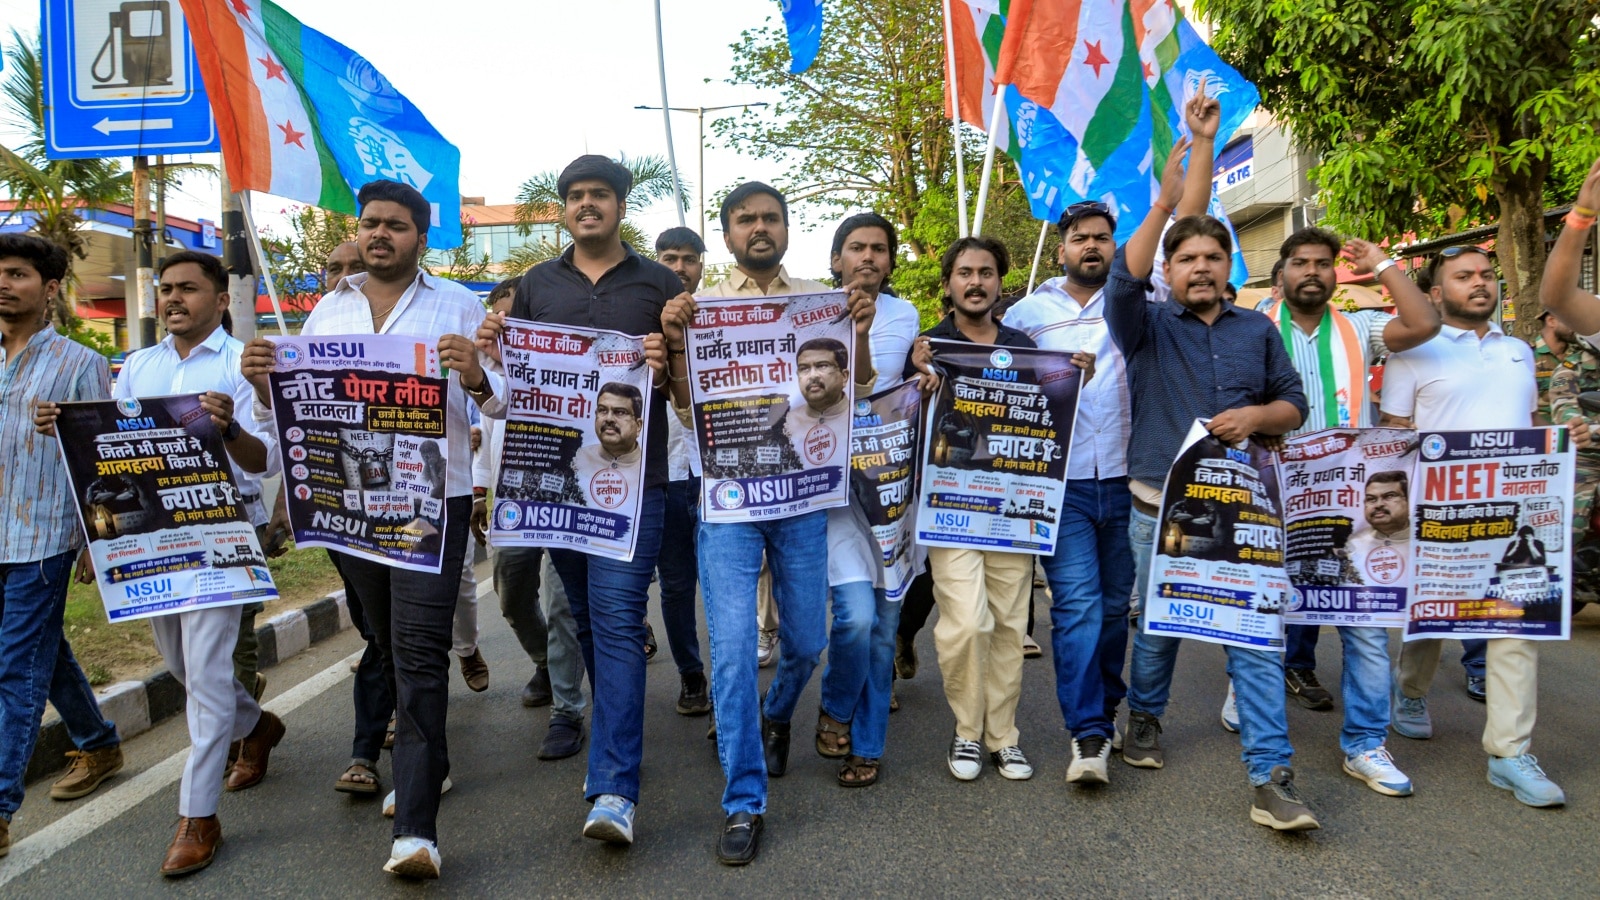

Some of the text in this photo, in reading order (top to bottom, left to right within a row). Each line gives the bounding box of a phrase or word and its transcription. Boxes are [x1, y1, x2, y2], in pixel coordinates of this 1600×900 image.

[694, 306, 774, 327] नीट पेपर लीक
[794, 305, 842, 326] LEAKED
[528, 332, 552, 350] पेपर
[554, 336, 582, 352] लीक
[695, 328, 724, 340] मामले में
[308, 342, 364, 358] NSUI
[600, 352, 640, 365] LEAKED
[540, 368, 580, 390] प्रधान
[582, 370, 600, 392] जी
[698, 357, 792, 392] इस्तीफा दो!
[982, 368, 1018, 382] NSUI
[278, 372, 440, 407] नीट पेपर लीक
[955, 383, 1048, 410] जितने भी छात्रों ने
[299, 404, 358, 420] मामला
[568, 393, 592, 418] दो!
[954, 398, 1054, 427] आत्महत्या किया है,
[116, 417, 156, 431] NSUI
[378, 410, 430, 421] छात्रों के भविष्य
[350, 432, 374, 441] NEET
[992, 423, 1057, 439] हम उन सभी छात्रों के
[1470, 431, 1515, 448] NSUI
[97, 436, 202, 459] जितने भी छात्रों ने
[398, 440, 418, 451] परीक्षा
[864, 436, 878, 452] भी
[882, 430, 910, 450] छात्रों
[986, 434, 1038, 460] न्याय
[1364, 441, 1408, 457] LEAKED
[96, 451, 218, 476] आत्महत्या किया है,
[399, 450, 412, 460] नहीं,
[364, 466, 387, 478] LEAK
[396, 460, 424, 472] धांधली
[992, 458, 1048, 473] की मांग करते हैं!
[1312, 466, 1346, 486] प्रधान
[1349, 462, 1366, 483] जी
[157, 472, 228, 486] हम उन सभी छात्रों के
[400, 472, 416, 480] चाहिए
[1194, 467, 1234, 486] जितने
[1424, 459, 1561, 502] NEET पेपर लीक
[396, 480, 430, 494] हमें न्याय!
[596, 485, 622, 496] इस्तीफा
[748, 478, 793, 504] NSUI
[1184, 484, 1252, 505] आत्महत्या
[1502, 480, 1548, 496] मामला
[157, 483, 220, 510] न्याय
[370, 494, 384, 502] NEET
[1336, 484, 1360, 508] दो!
[173, 506, 238, 524] की मांग करते हैं!
[368, 504, 412, 514] अब नहीं चलेगी!
[1424, 503, 1516, 520] छात्रों के भविष्य के साथ
[1526, 501, 1551, 512] NEET
[312, 510, 368, 538] NSUI
[525, 505, 572, 528] NSUI
[936, 512, 970, 527] NSUI
[1532, 513, 1558, 526] LEAK
[1233, 522, 1277, 550] न्याय
[1421, 518, 1514, 543] खिलवाड़ बंद करो!
[125, 578, 172, 598] NSUI
[1306, 590, 1351, 610] NSUI
[1168, 602, 1214, 621] NSUI
[1414, 602, 1456, 618] NSUI
